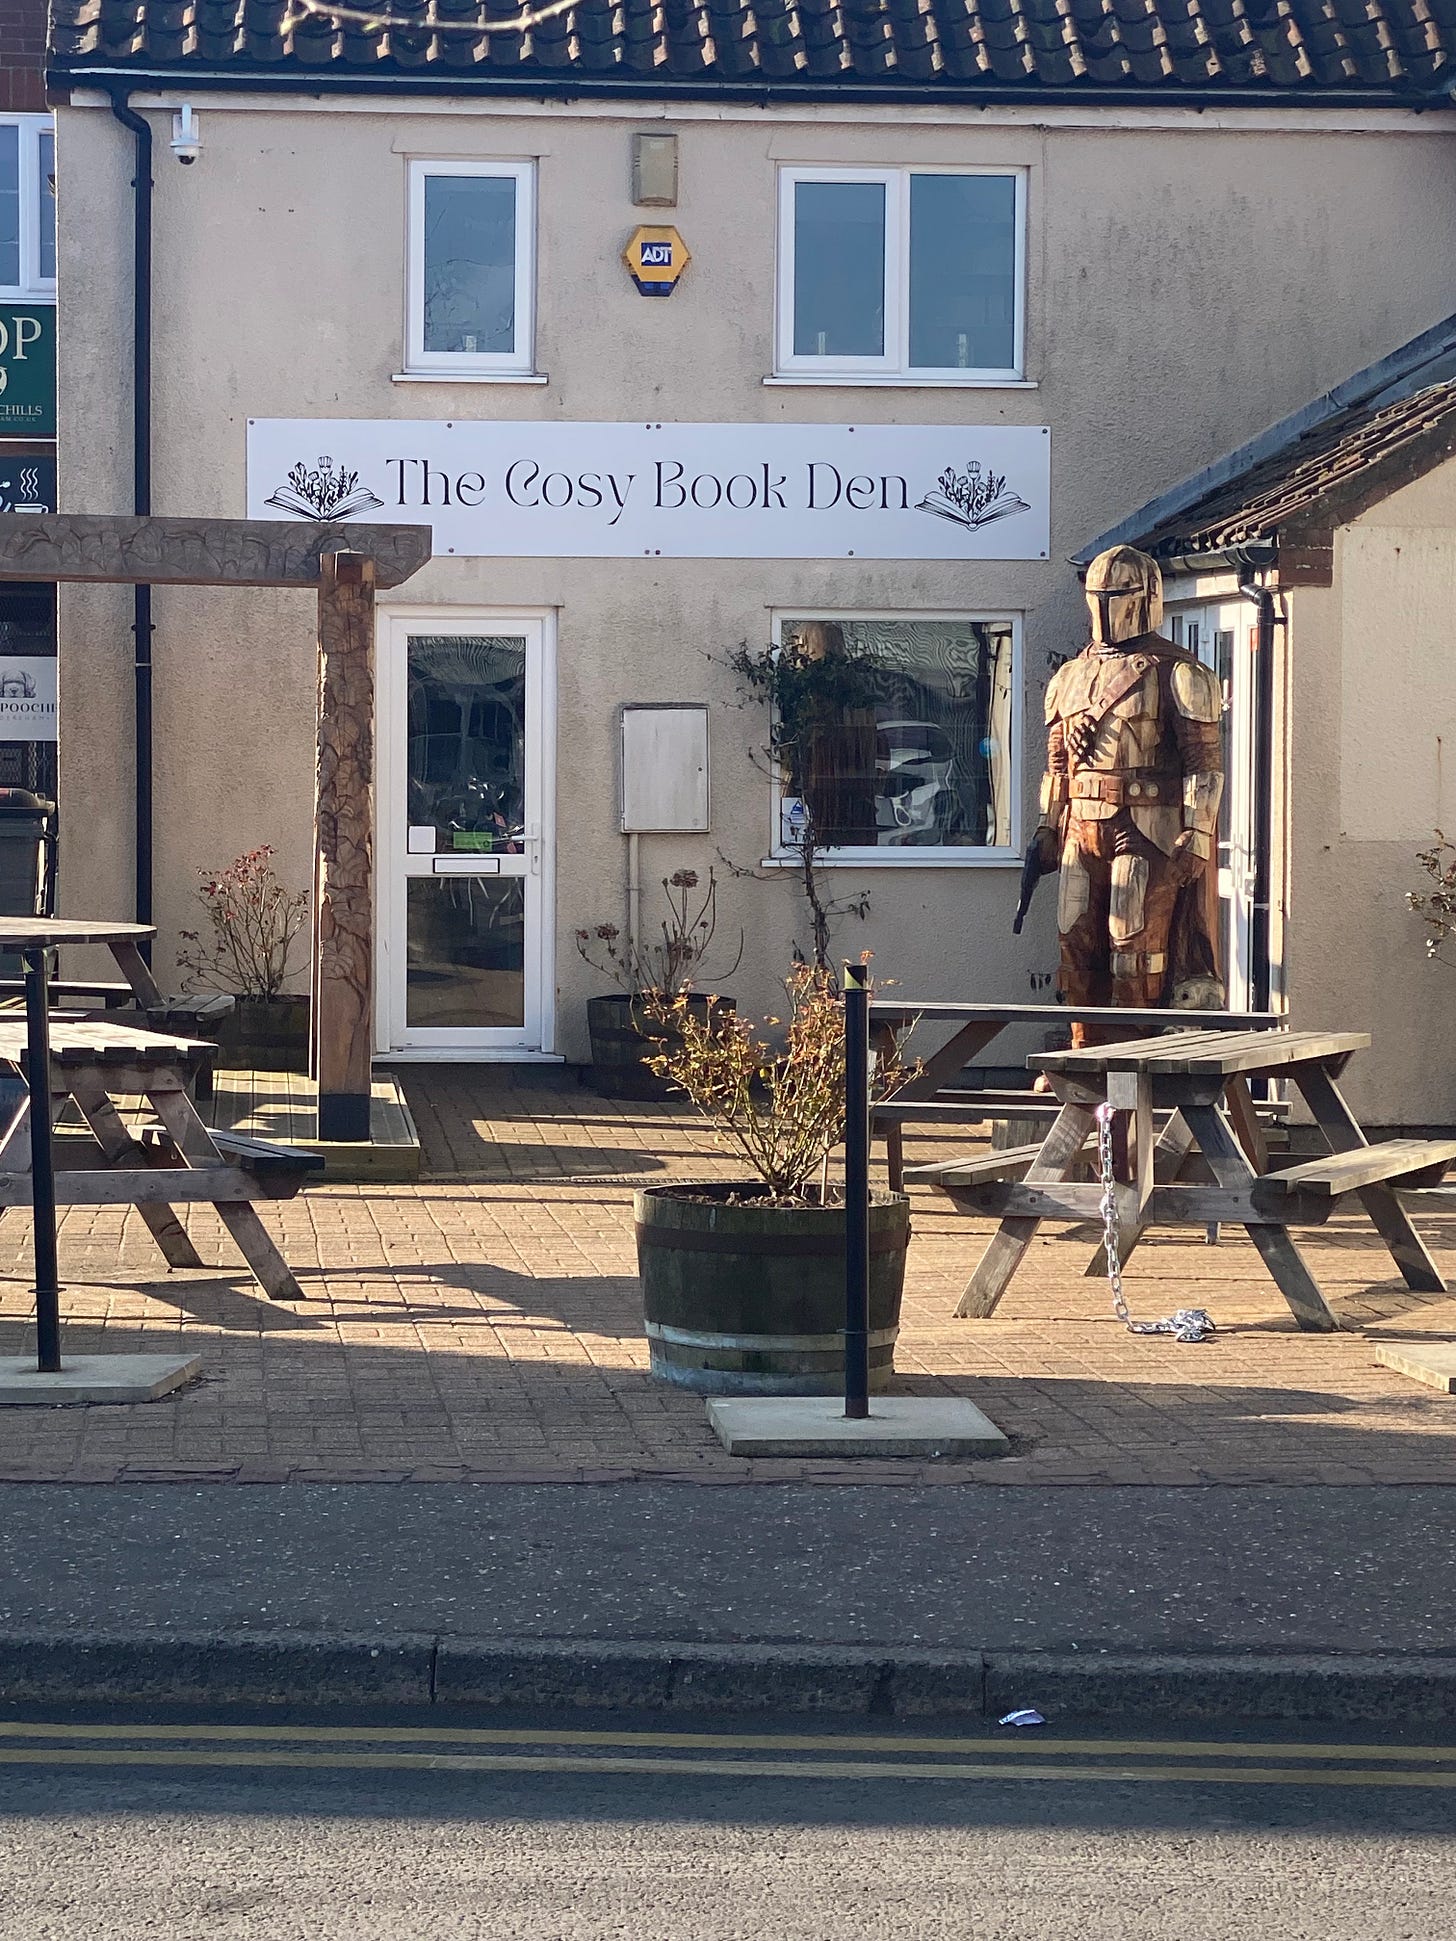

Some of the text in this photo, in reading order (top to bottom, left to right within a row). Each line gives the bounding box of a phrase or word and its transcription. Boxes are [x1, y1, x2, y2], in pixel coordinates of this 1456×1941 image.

[641, 246, 672, 263] ADT
[0, 316, 42, 360] P
[385, 458, 910, 526] The Cosy Book Den
